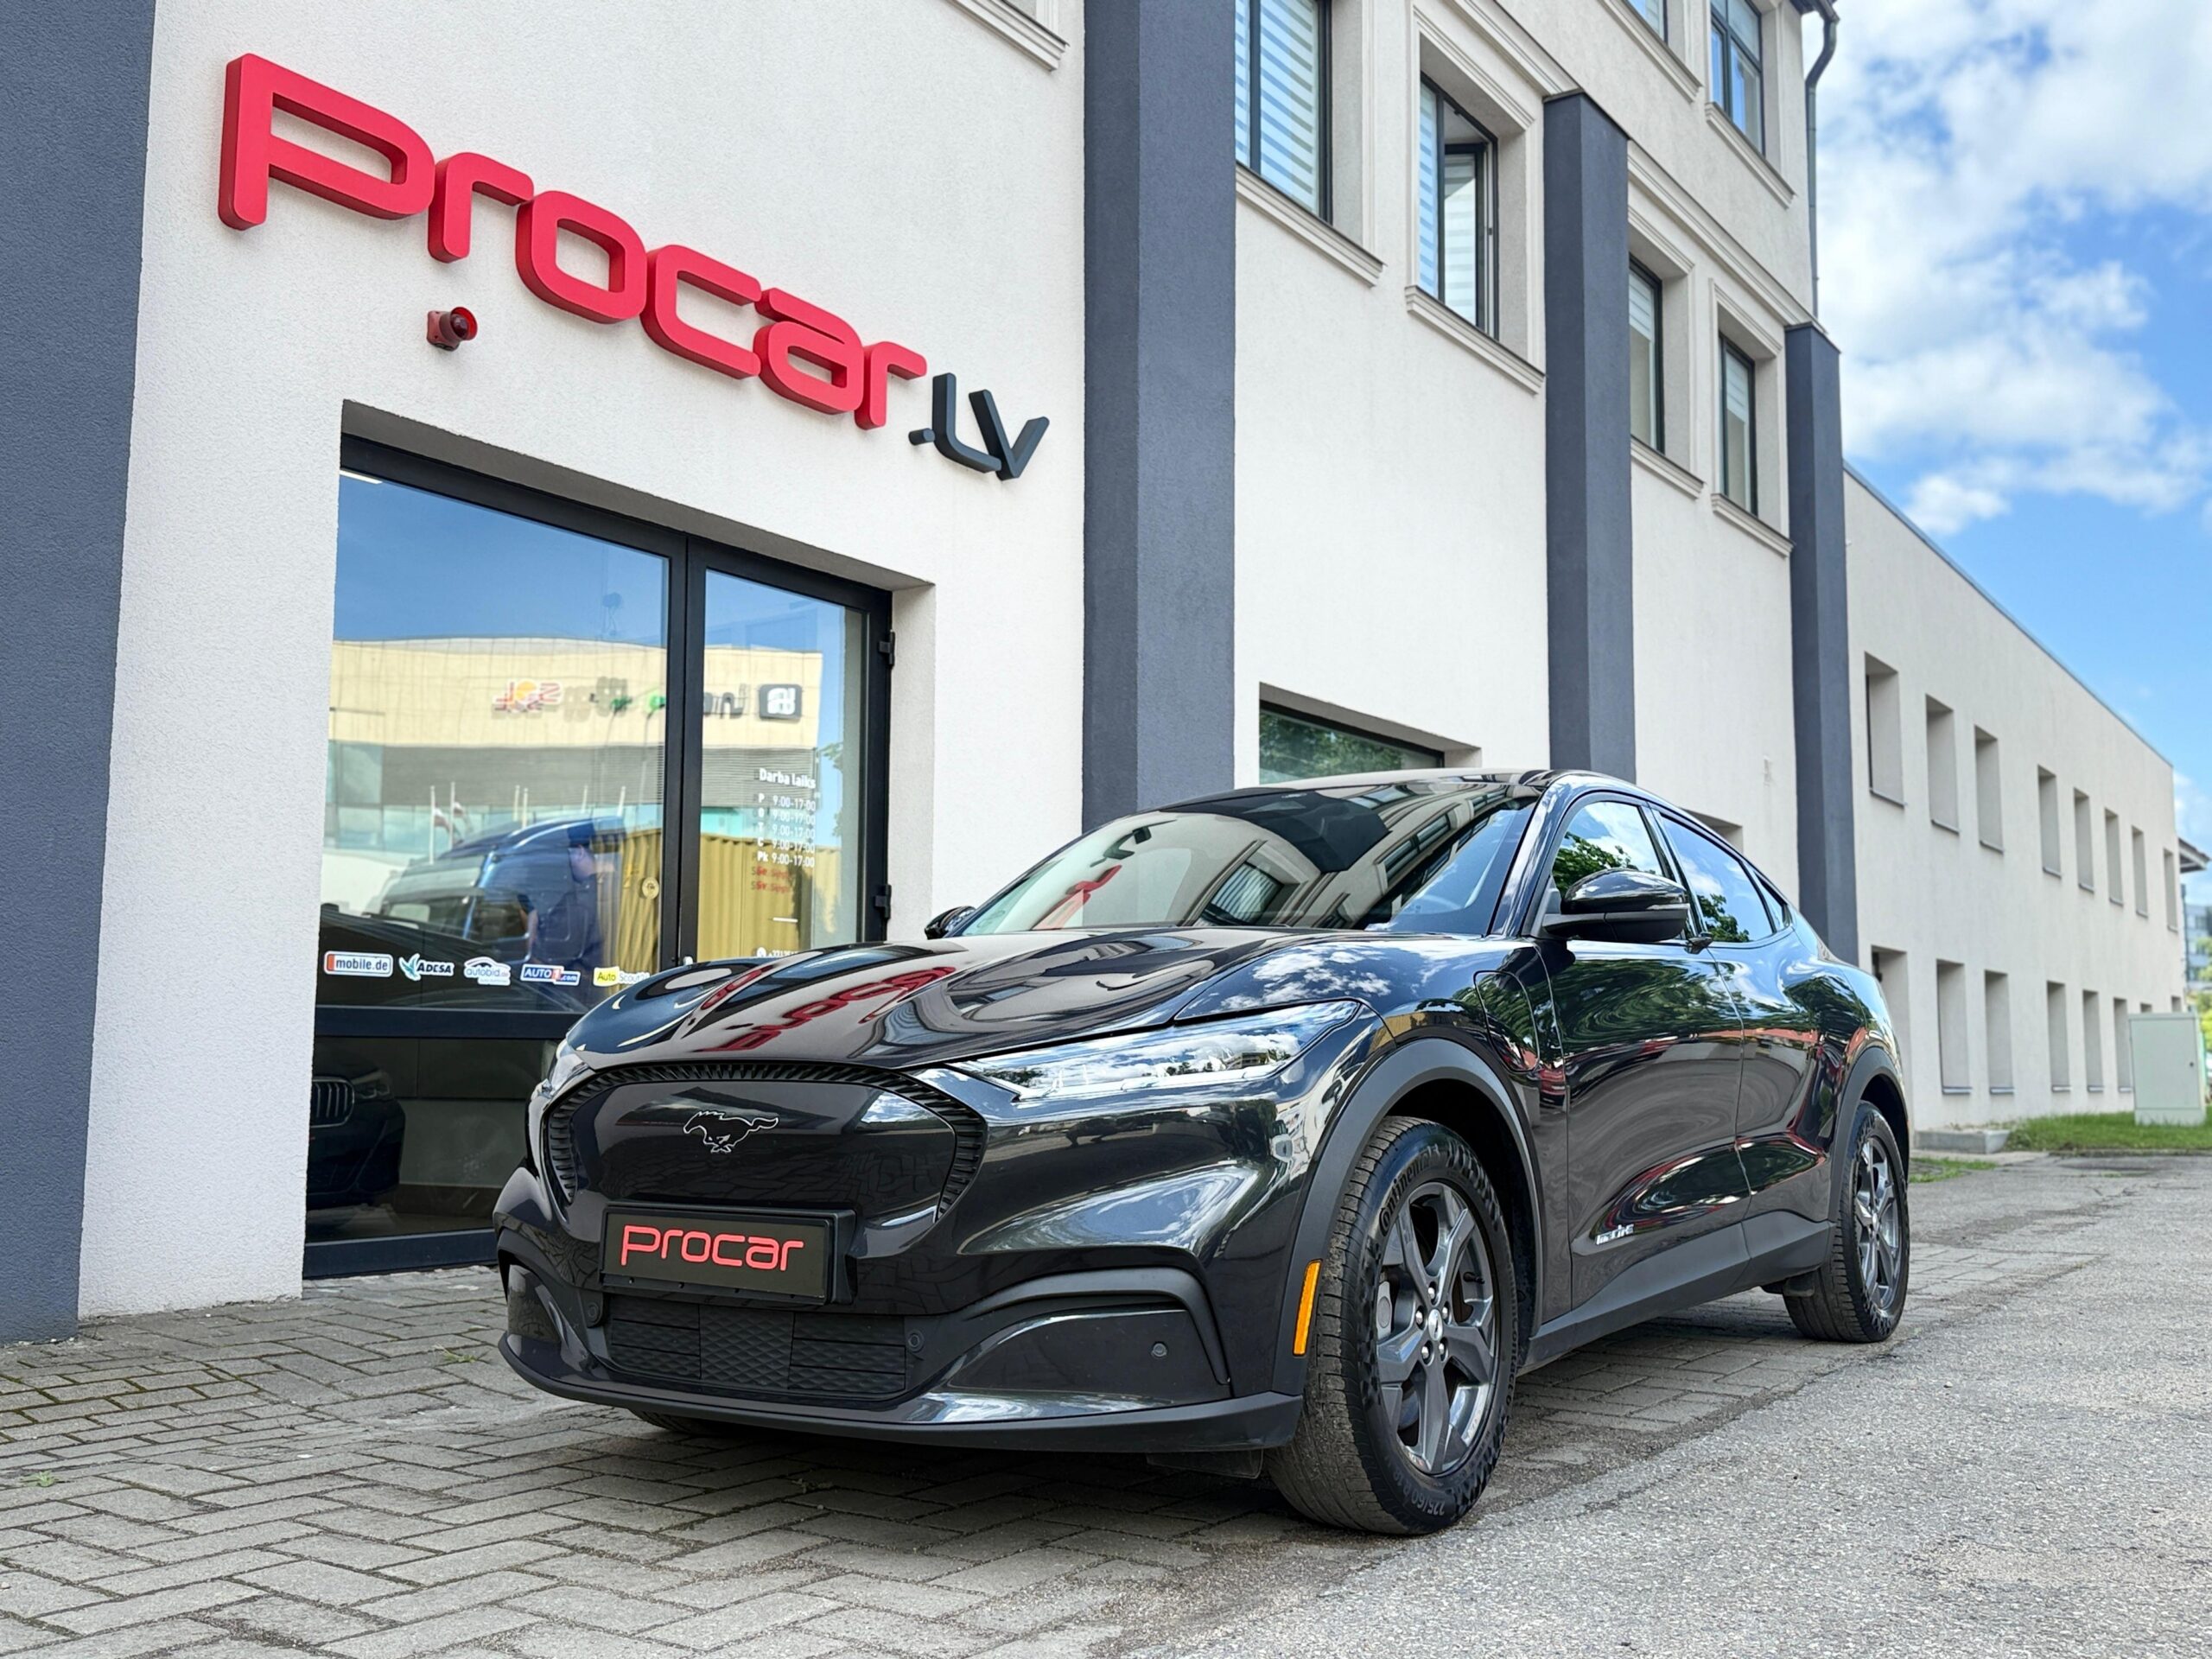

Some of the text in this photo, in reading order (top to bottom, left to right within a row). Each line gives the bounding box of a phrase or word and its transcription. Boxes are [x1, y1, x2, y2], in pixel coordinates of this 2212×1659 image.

[759, 767, 817, 789] Darba laiks
[772, 795, 817, 811] 9:00-17:00
[772, 810, 816, 825] 9:00-17:00
[772, 824, 816, 840] 9:00-17:00
[772, 838, 815, 854] 9:00-17:00
[757, 851, 815, 868] Pk 9:00-17:00
[335, 957, 389, 972] mobile.de
[416, 959, 453, 974] ADESA
